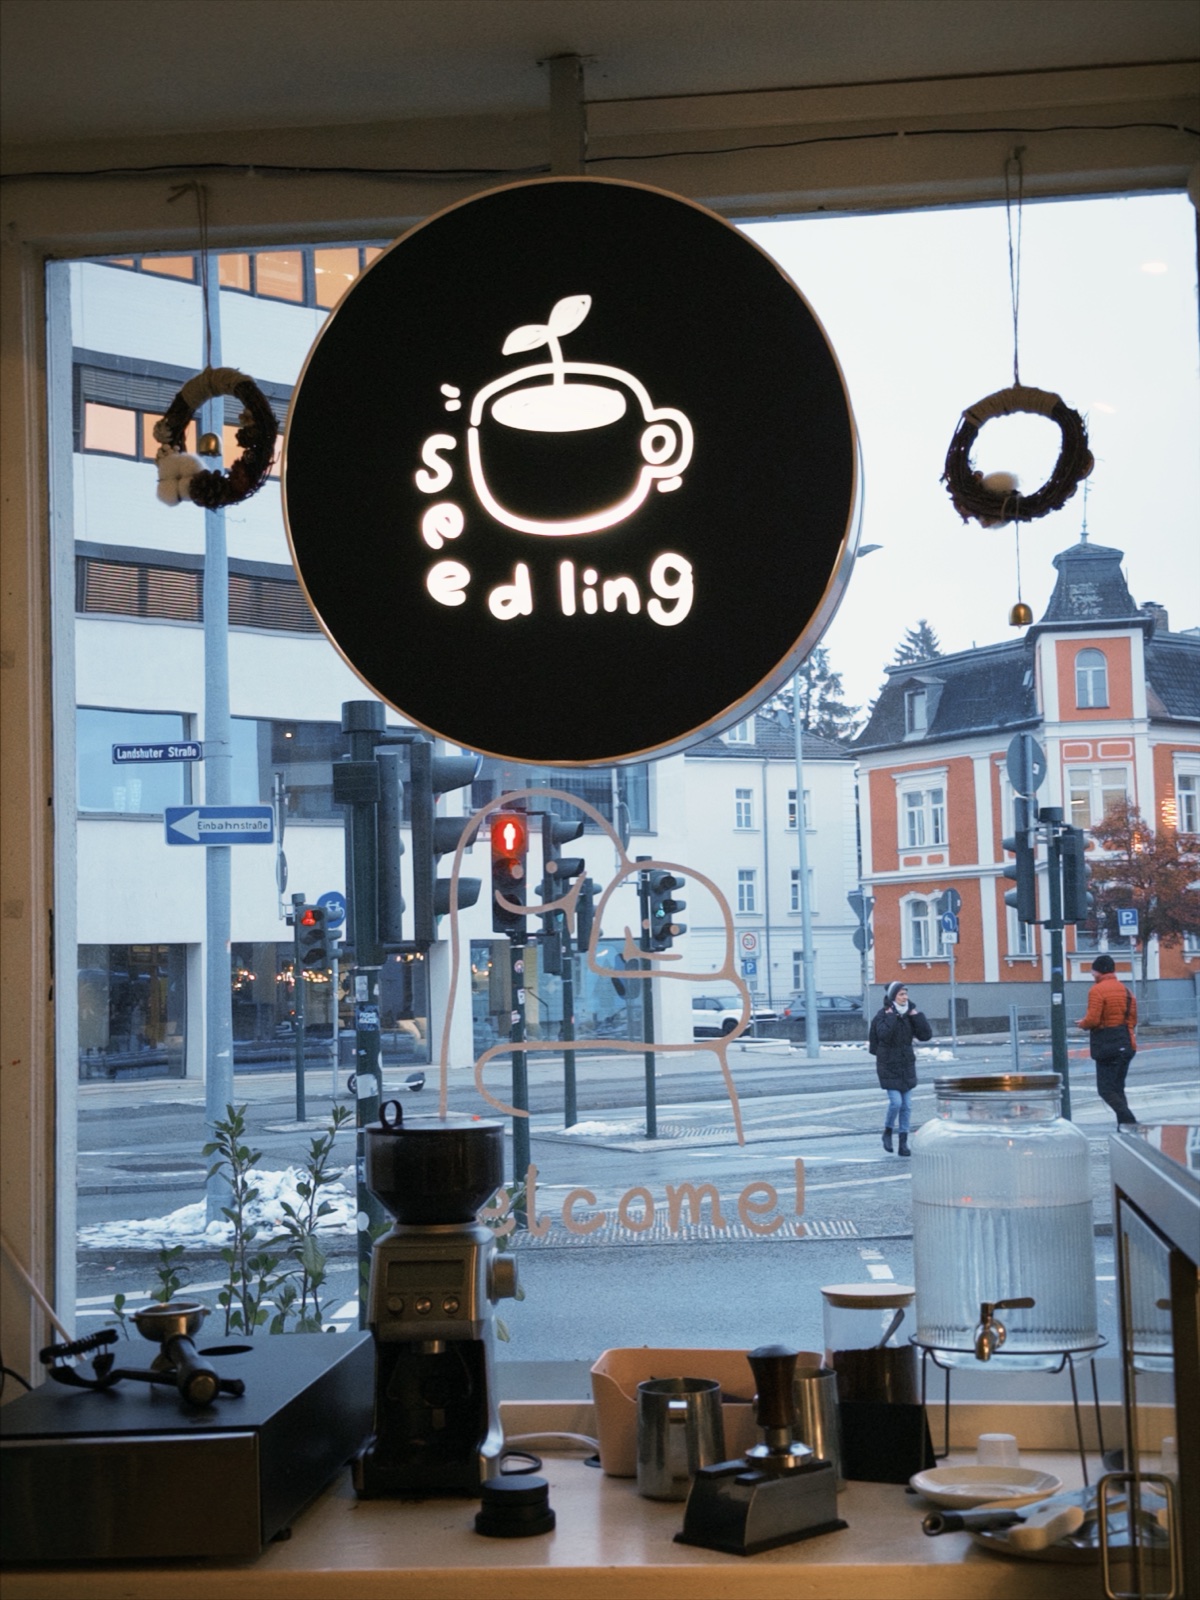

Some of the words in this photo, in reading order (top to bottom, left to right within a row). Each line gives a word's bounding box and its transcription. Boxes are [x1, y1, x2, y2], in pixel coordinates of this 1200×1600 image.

[117, 747, 163, 760] Landshuter
[168, 746, 197, 758] Straße
[197, 820, 268, 831] Einbahnstraße
[1122, 912, 1132, 924] P
[480, 1158, 807, 1237] elcome!
